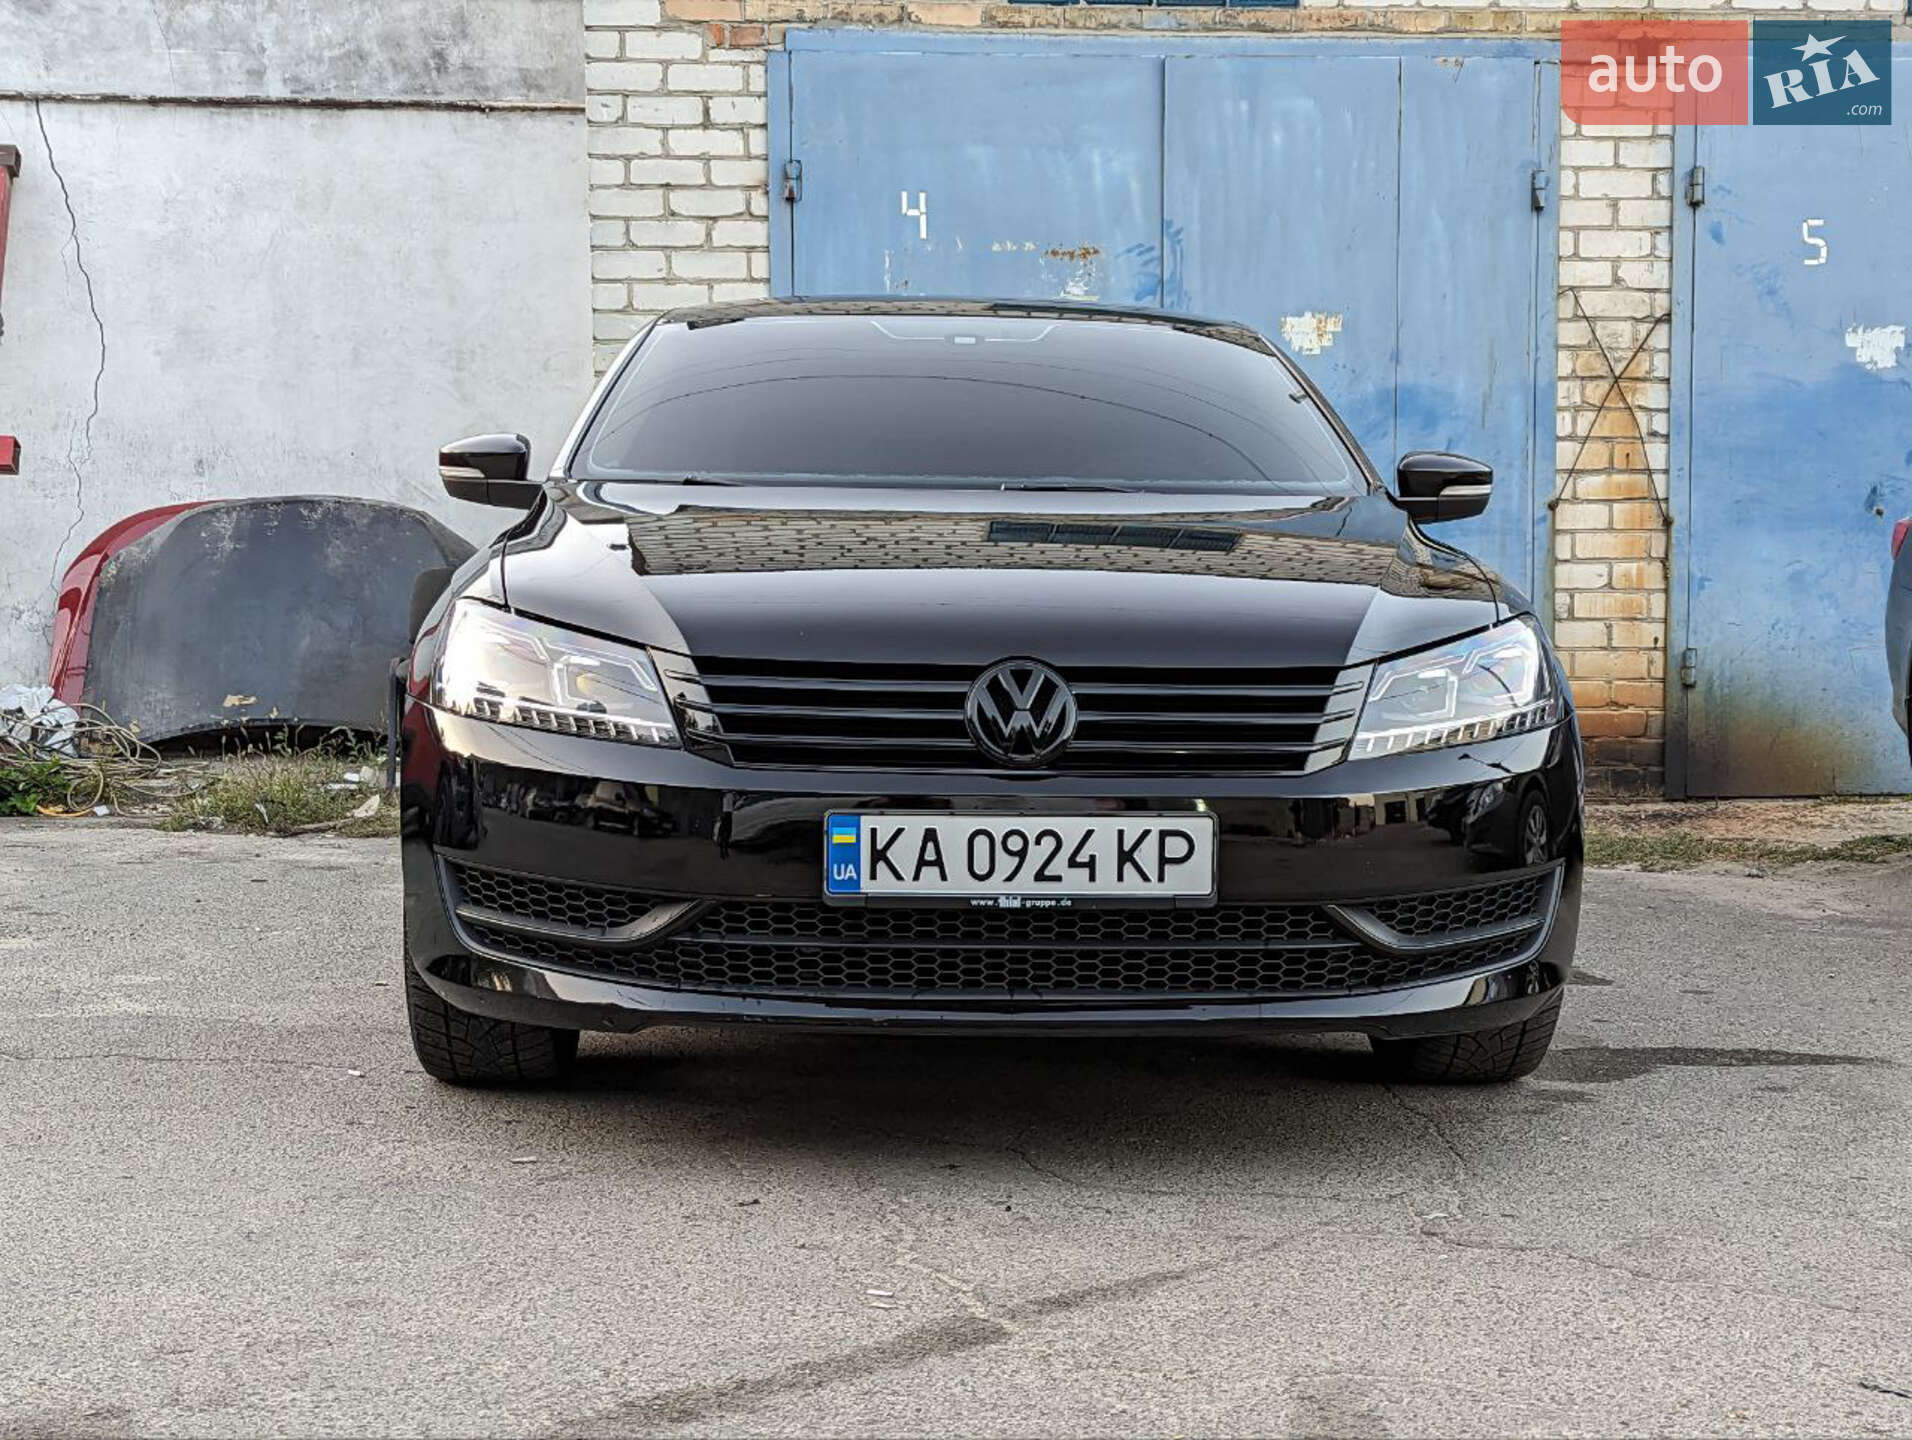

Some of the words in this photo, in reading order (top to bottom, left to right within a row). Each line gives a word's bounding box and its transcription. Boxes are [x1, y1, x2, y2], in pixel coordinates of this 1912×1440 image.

[902, 190, 927, 239] 4
[1802, 218, 1828, 265] 5
[833, 864, 857, 880] UA
[869, 827, 948, 882] KA
[967, 828, 1097, 883] 0924
[1116, 828, 1196, 883] KP
